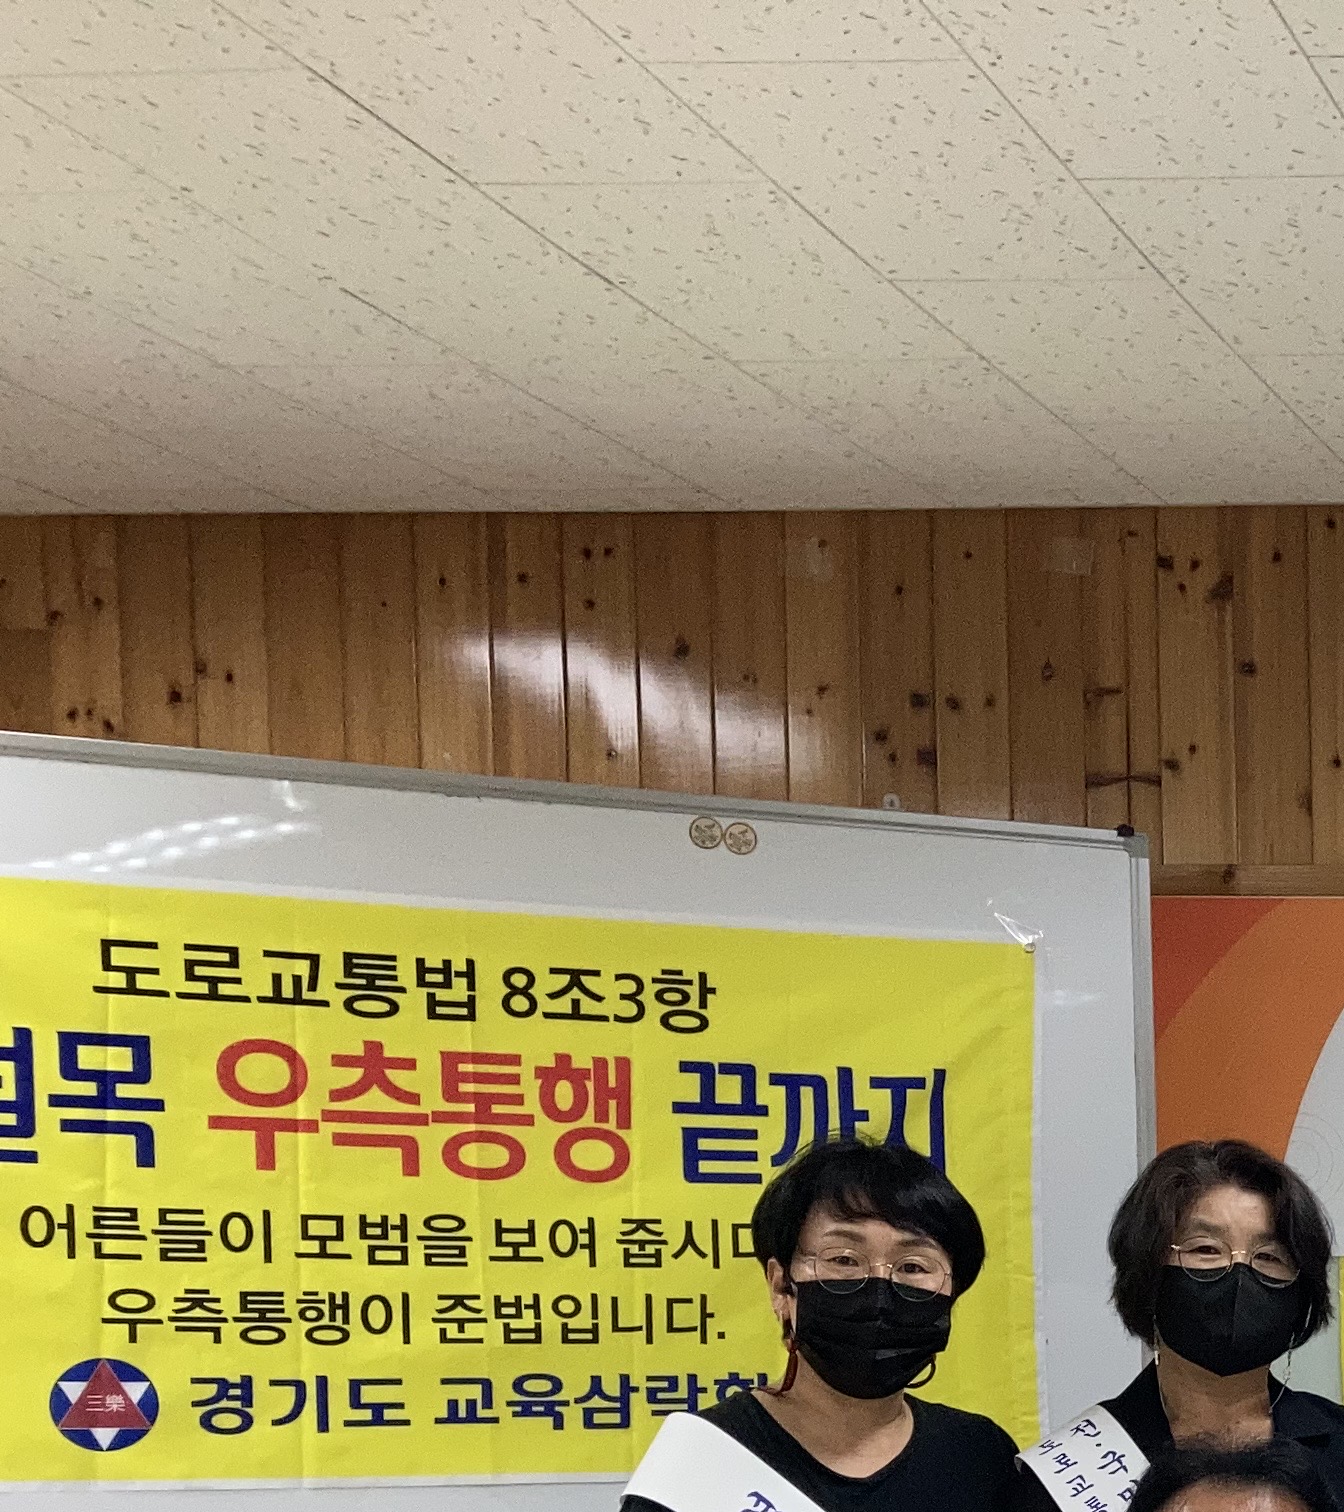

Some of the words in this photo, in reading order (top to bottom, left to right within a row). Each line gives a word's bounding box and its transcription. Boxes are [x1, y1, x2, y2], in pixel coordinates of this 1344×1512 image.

[93, 938, 477, 1022] 도로교통법
[501, 966, 717, 1034] 8조3항
[208, 1038, 632, 1184] 우측통행
[672, 1060, 946, 1185] 끝까지
[19, 1203, 272, 1263] 어른들이
[295, 1213, 473, 1267] 모범을
[489, 1216, 597, 1268] 보여
[101, 1288, 411, 1346] 우측통행이
[431, 1291, 726, 1345] 준법입니다.
[190, 1374, 412, 1436] 경기도
